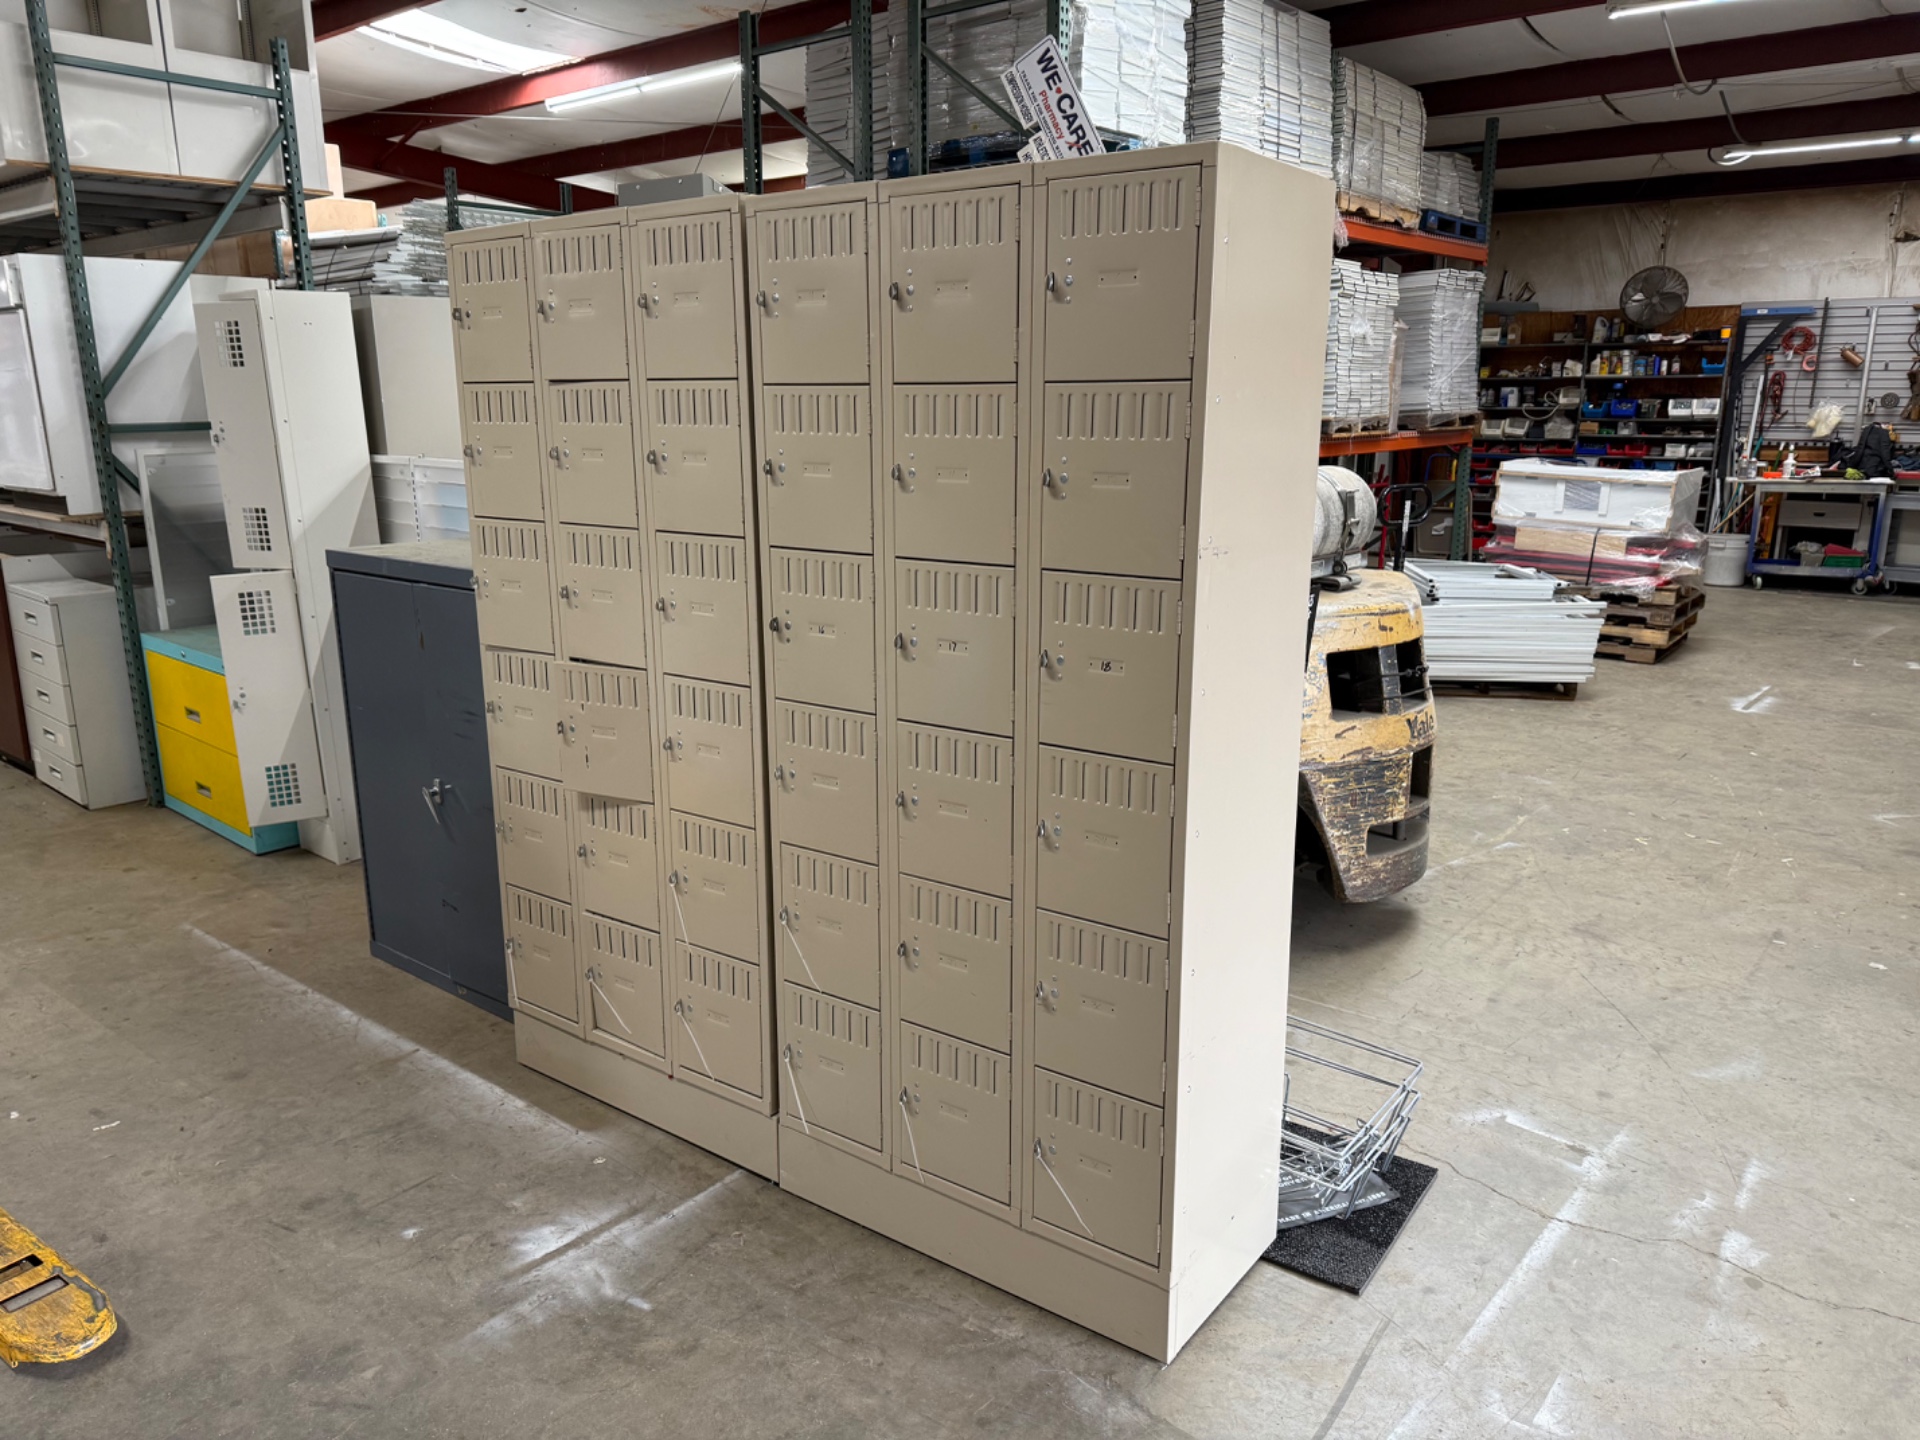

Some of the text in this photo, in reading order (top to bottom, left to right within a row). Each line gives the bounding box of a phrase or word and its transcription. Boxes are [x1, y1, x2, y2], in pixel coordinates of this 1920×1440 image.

[1037, 47, 1094, 156] WE CARE
[1039, 89, 1065, 141] Pharmacy
[948, 641, 957, 652] 17
[1101, 661, 1112, 672] 18
[1406, 711, 1434, 738] Yale
